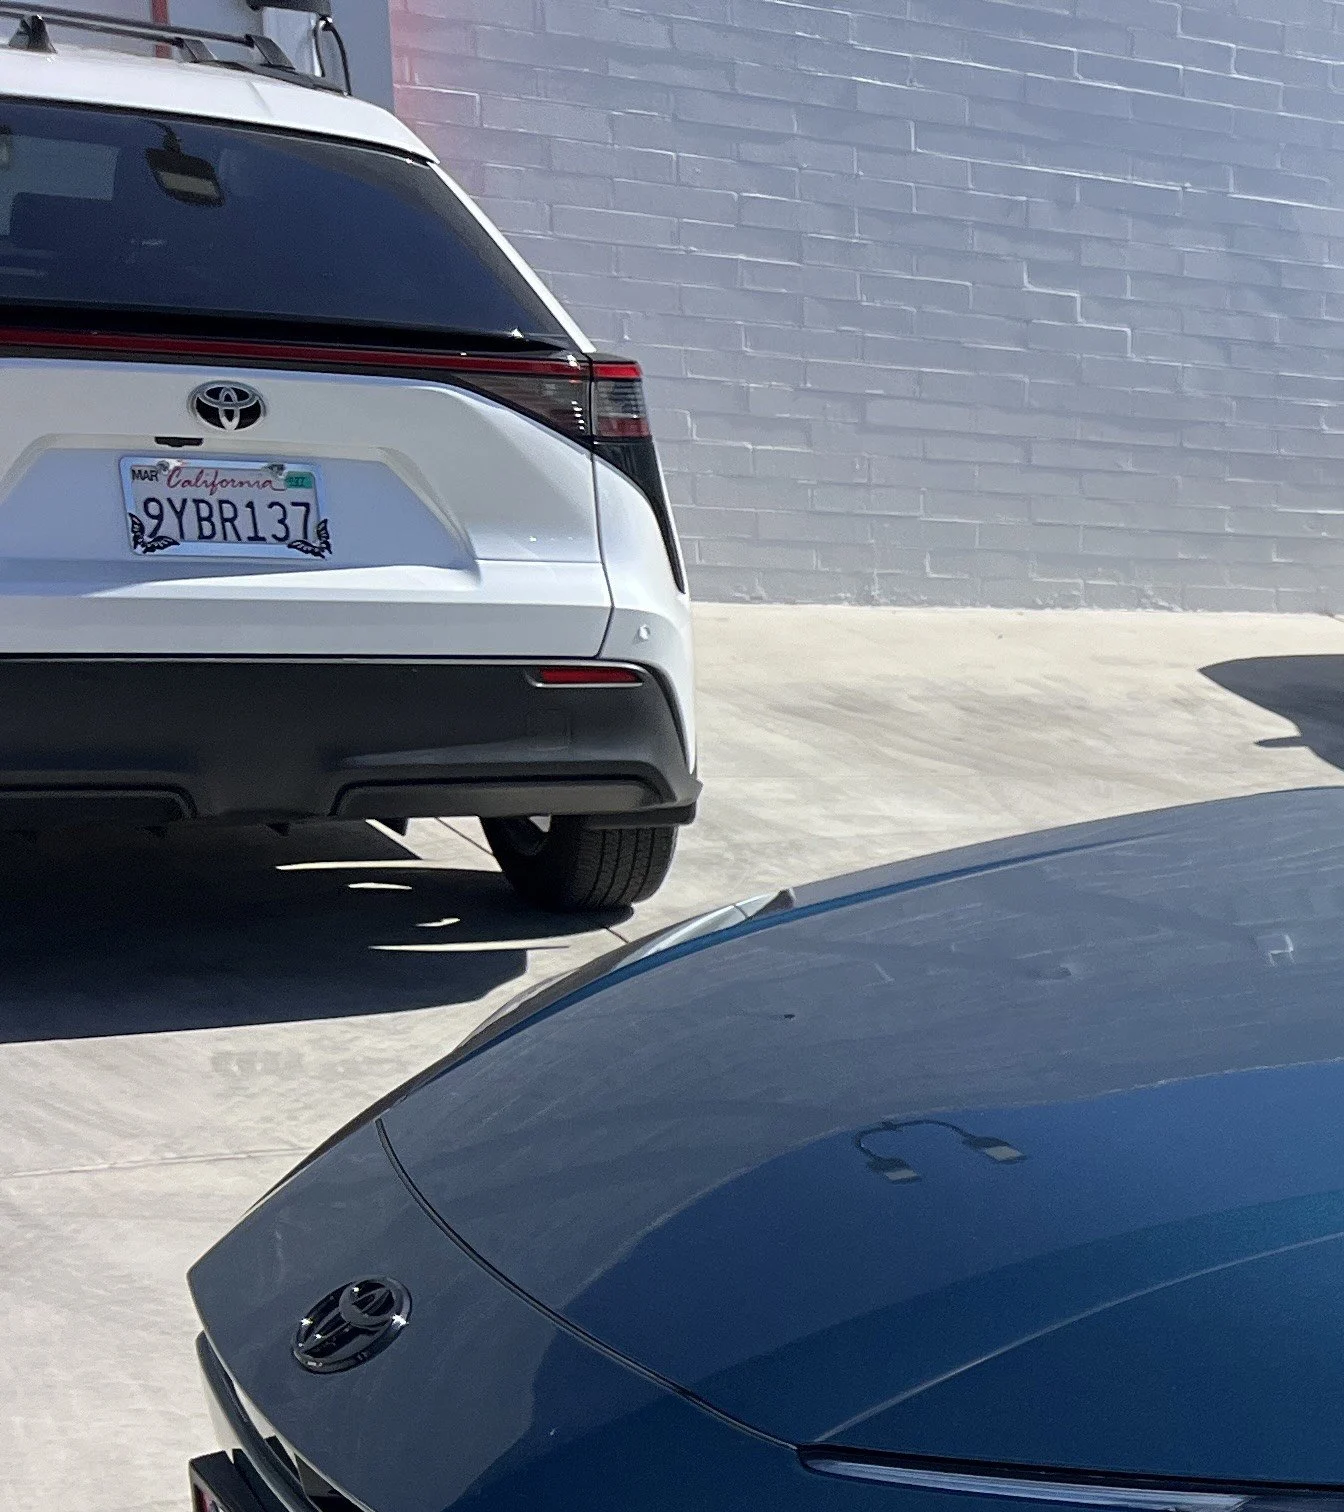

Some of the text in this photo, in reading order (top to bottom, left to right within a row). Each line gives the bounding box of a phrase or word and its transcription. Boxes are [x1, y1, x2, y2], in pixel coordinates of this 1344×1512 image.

[131, 469, 159, 482] MAR
[166, 466, 287, 496] California
[143, 497, 311, 542] 9YBR137
